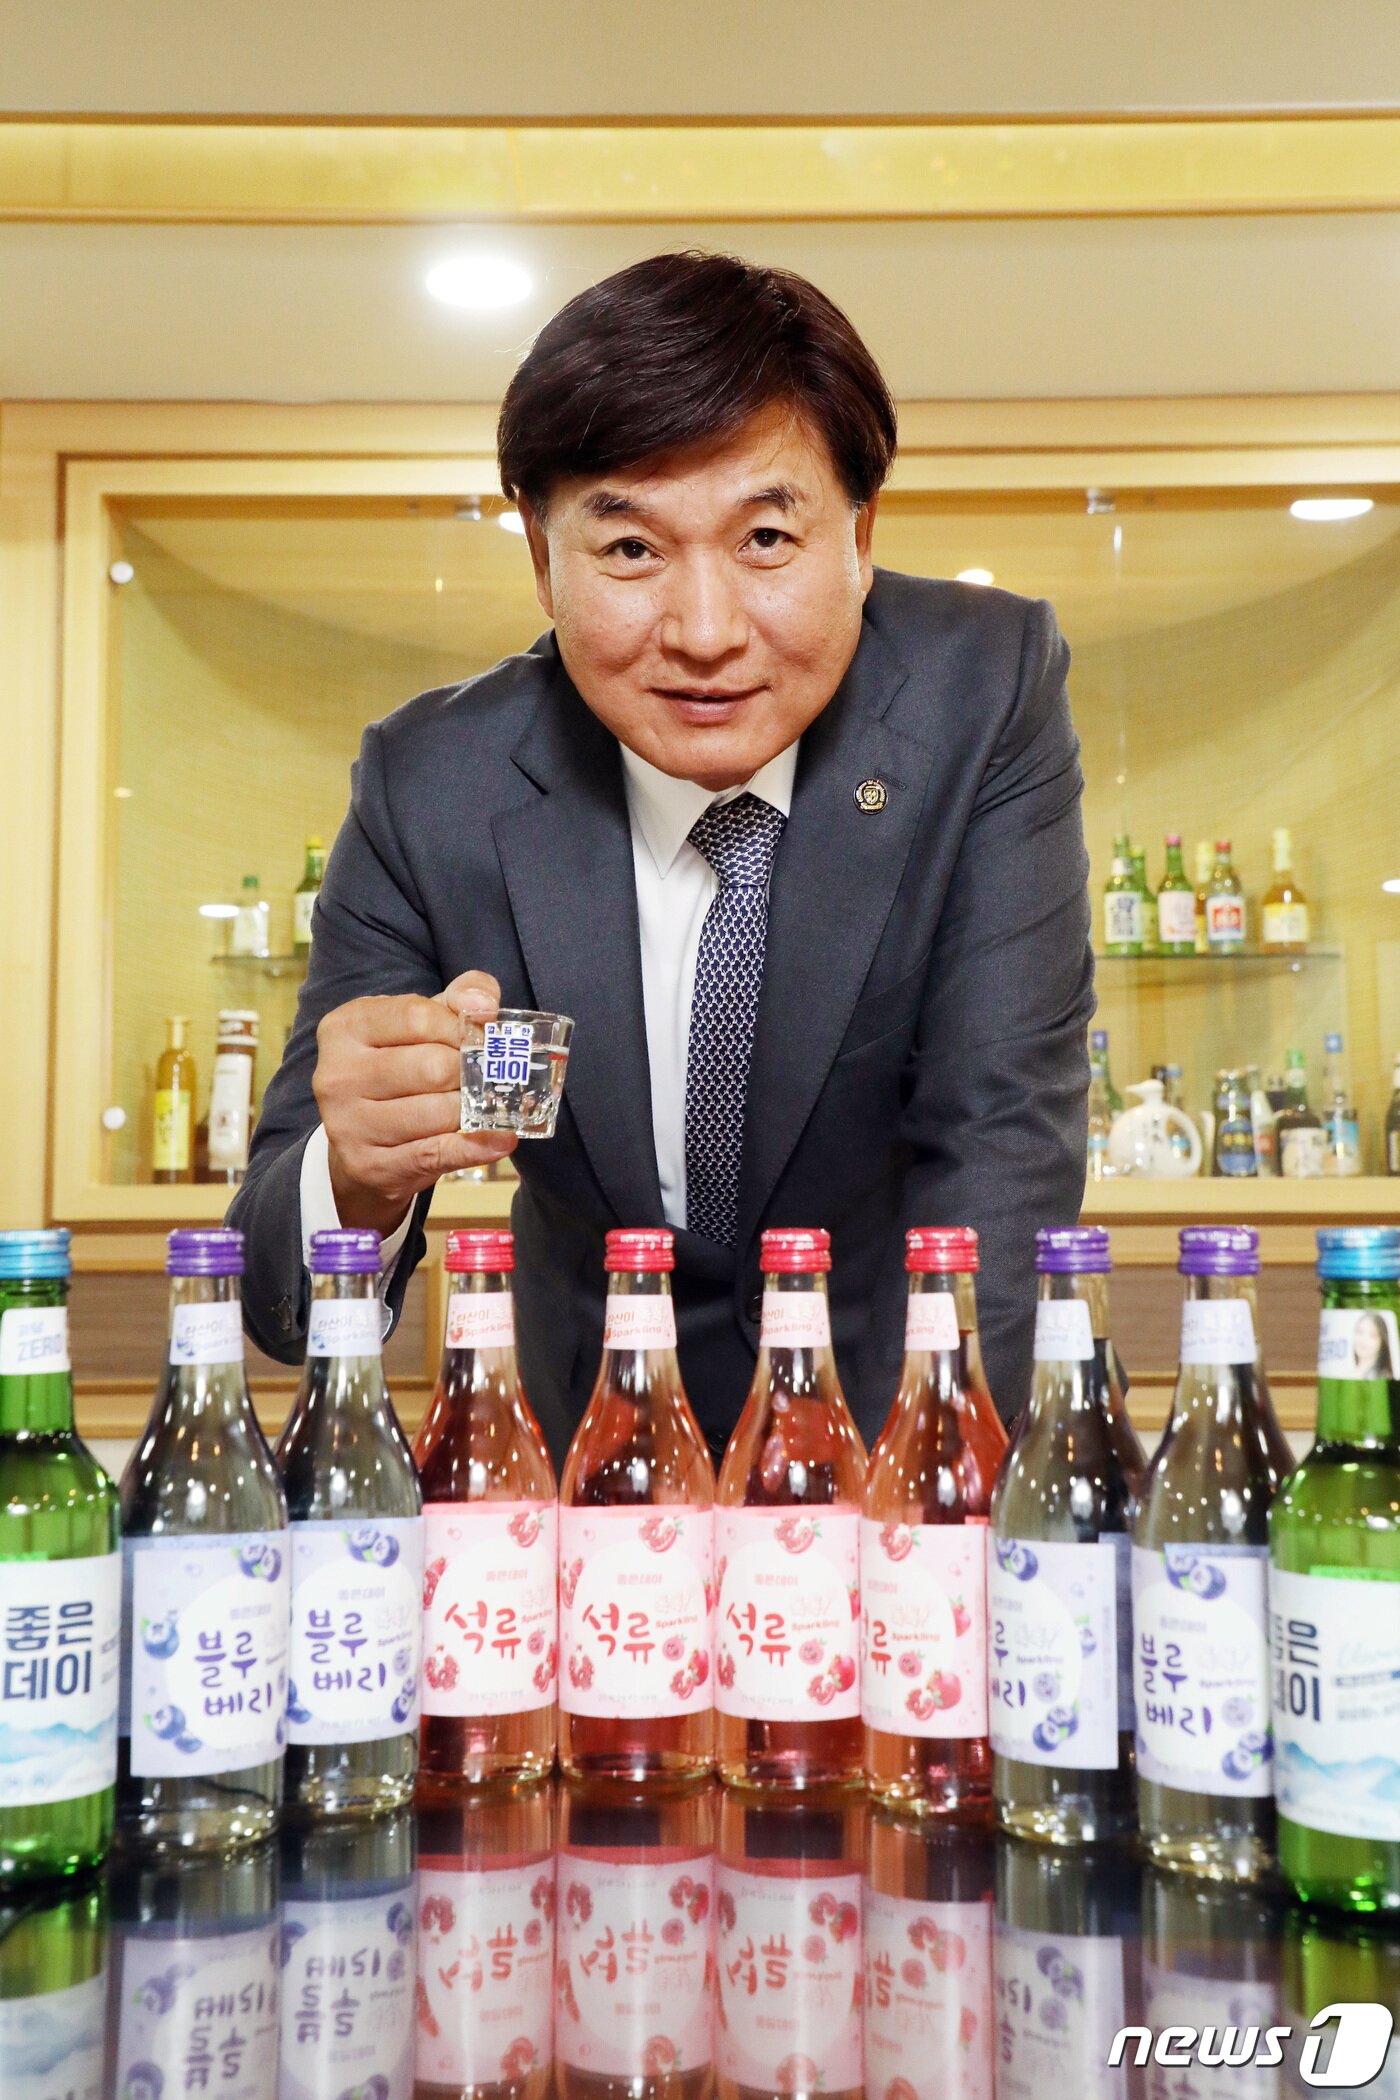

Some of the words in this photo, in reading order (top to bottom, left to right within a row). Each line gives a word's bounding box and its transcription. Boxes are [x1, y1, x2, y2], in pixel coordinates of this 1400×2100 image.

[487, 1037, 530, 1058] 좋은
[487, 1060, 529, 1081] 데이
[17, 1333, 62, 1363] ZERO
[6, 1601, 94, 1651] 좋은
[305, 1608, 368, 1664] 블루
[444, 1599, 522, 1661] 석류
[581, 1602, 656, 1665] 석류
[726, 1602, 792, 1668] 석류
[3, 1650, 92, 1700] 데이
[194, 1630, 258, 1688] 블루
[313, 1661, 387, 1692] 베리
[1140, 1632, 1188, 1694] 블루
[204, 1682, 272, 1716] 베리
[1145, 1700, 1213, 1737] 베리
